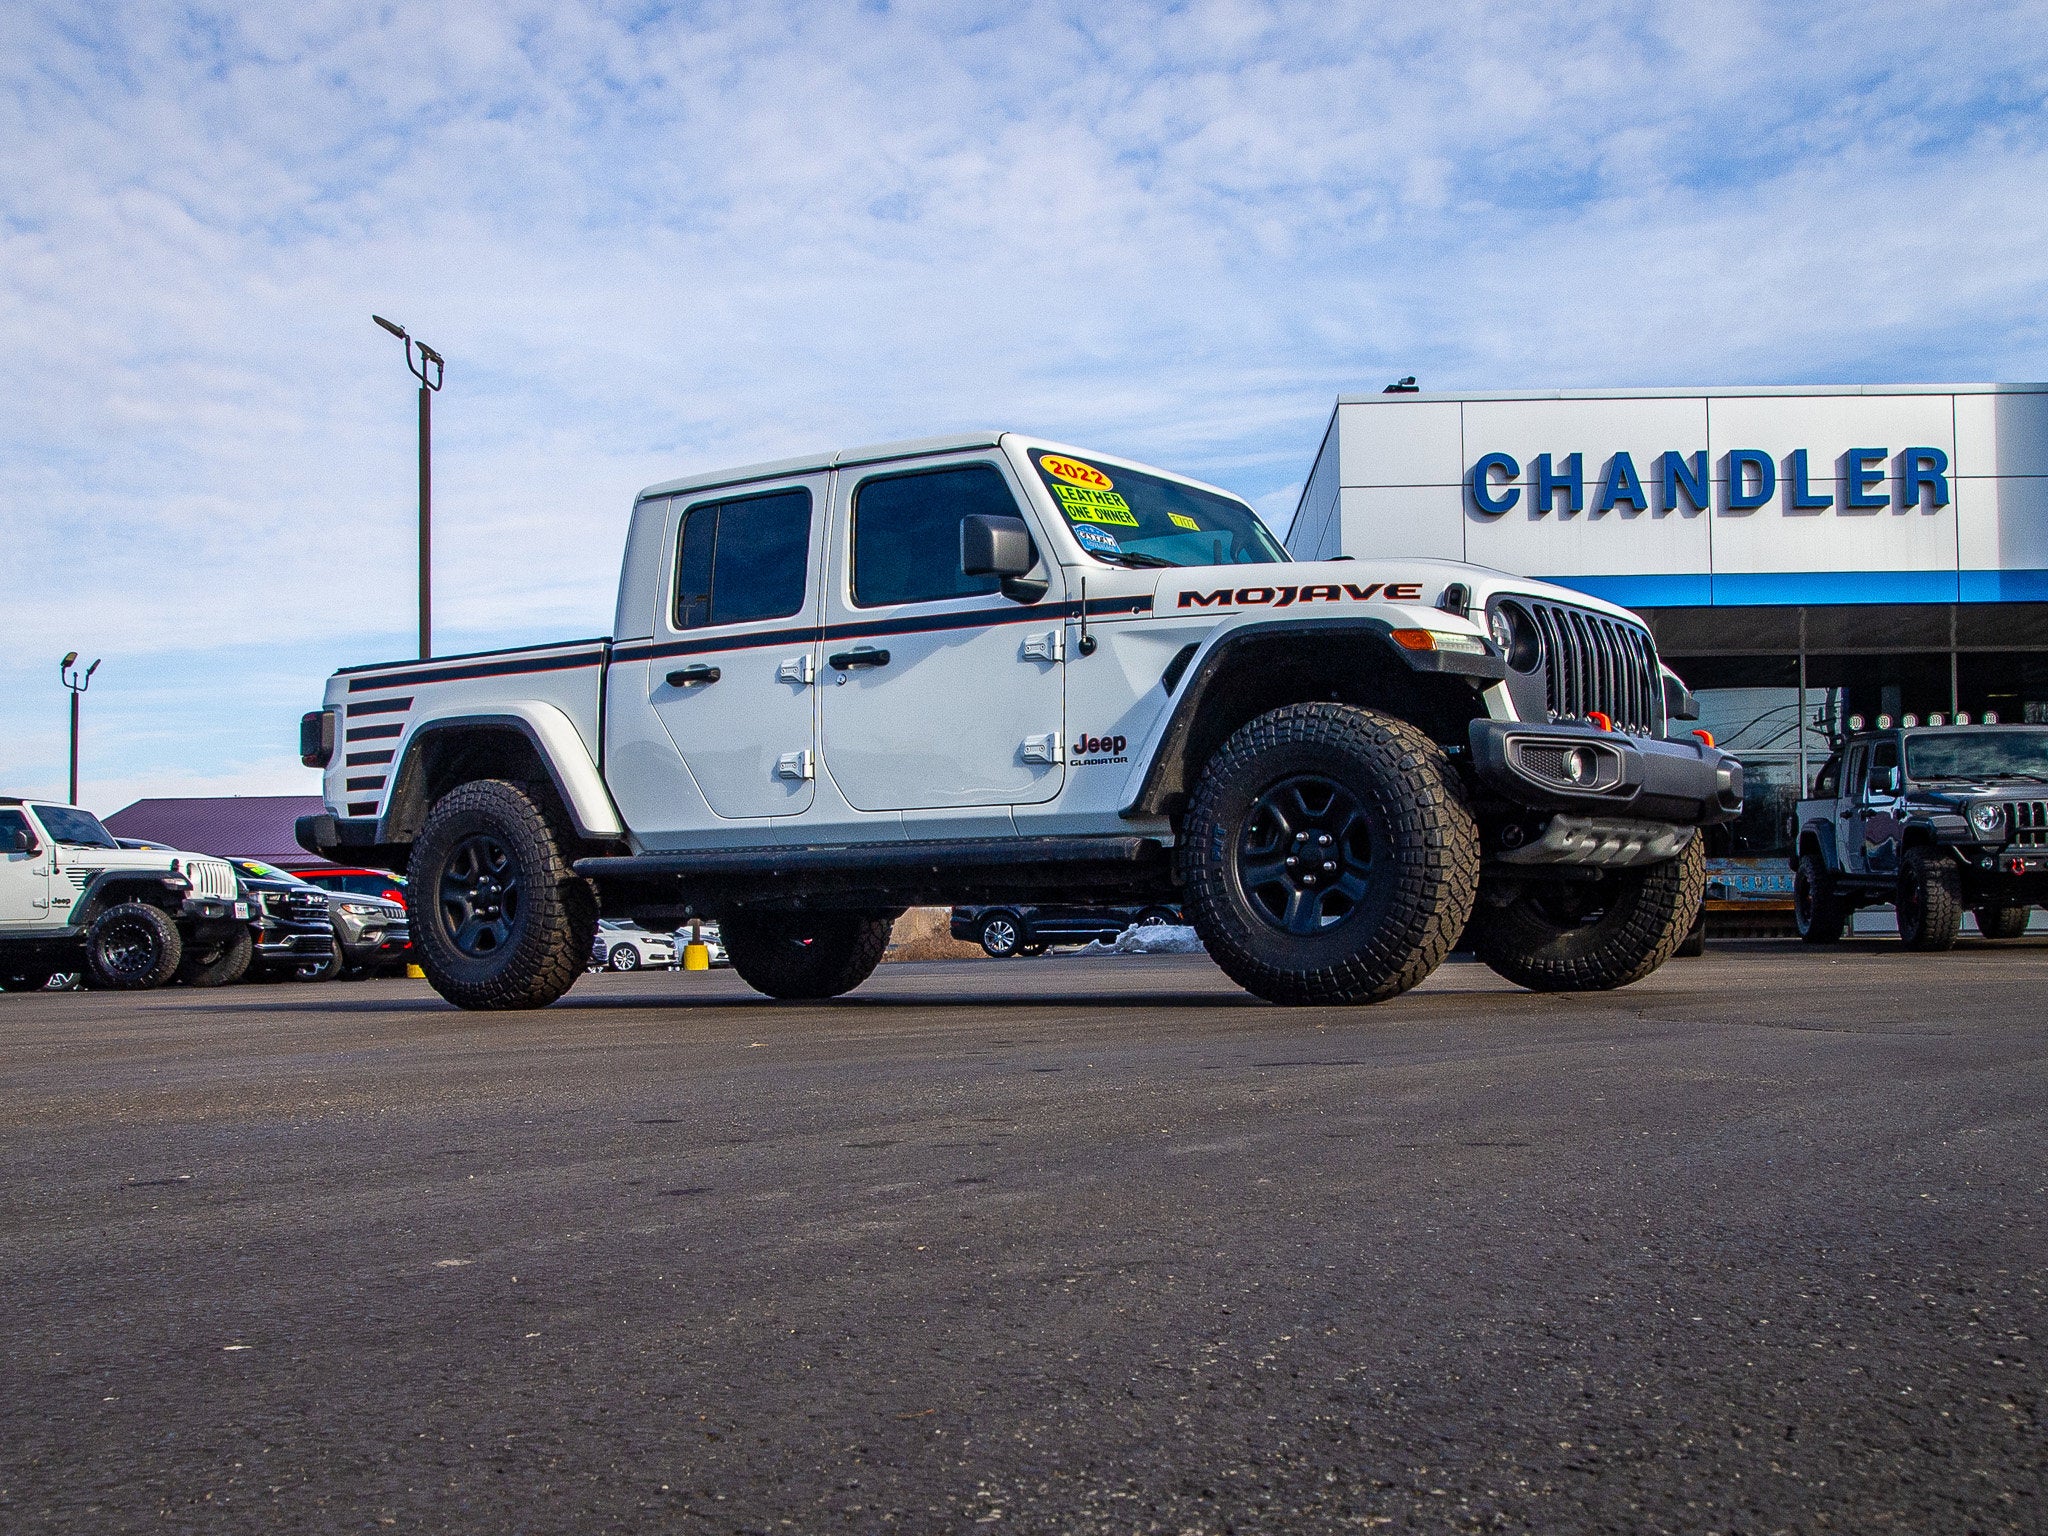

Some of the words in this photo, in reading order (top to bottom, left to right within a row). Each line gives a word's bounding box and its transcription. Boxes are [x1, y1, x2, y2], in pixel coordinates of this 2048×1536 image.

[1049, 460, 1107, 486] 2022
[1473, 447, 1950, 514] CHANDLER
[1057, 486, 1125, 507] LEATHER
[1067, 505, 1093, 519] ONE
[1094, 507, 1135, 523] OWNER
[1177, 583, 1423, 609] MOJAVE
[1072, 733, 1127, 756] Jeep
[1070, 756, 1128, 766] GLADIATOR
[51, 897, 71, 905] Jeep
